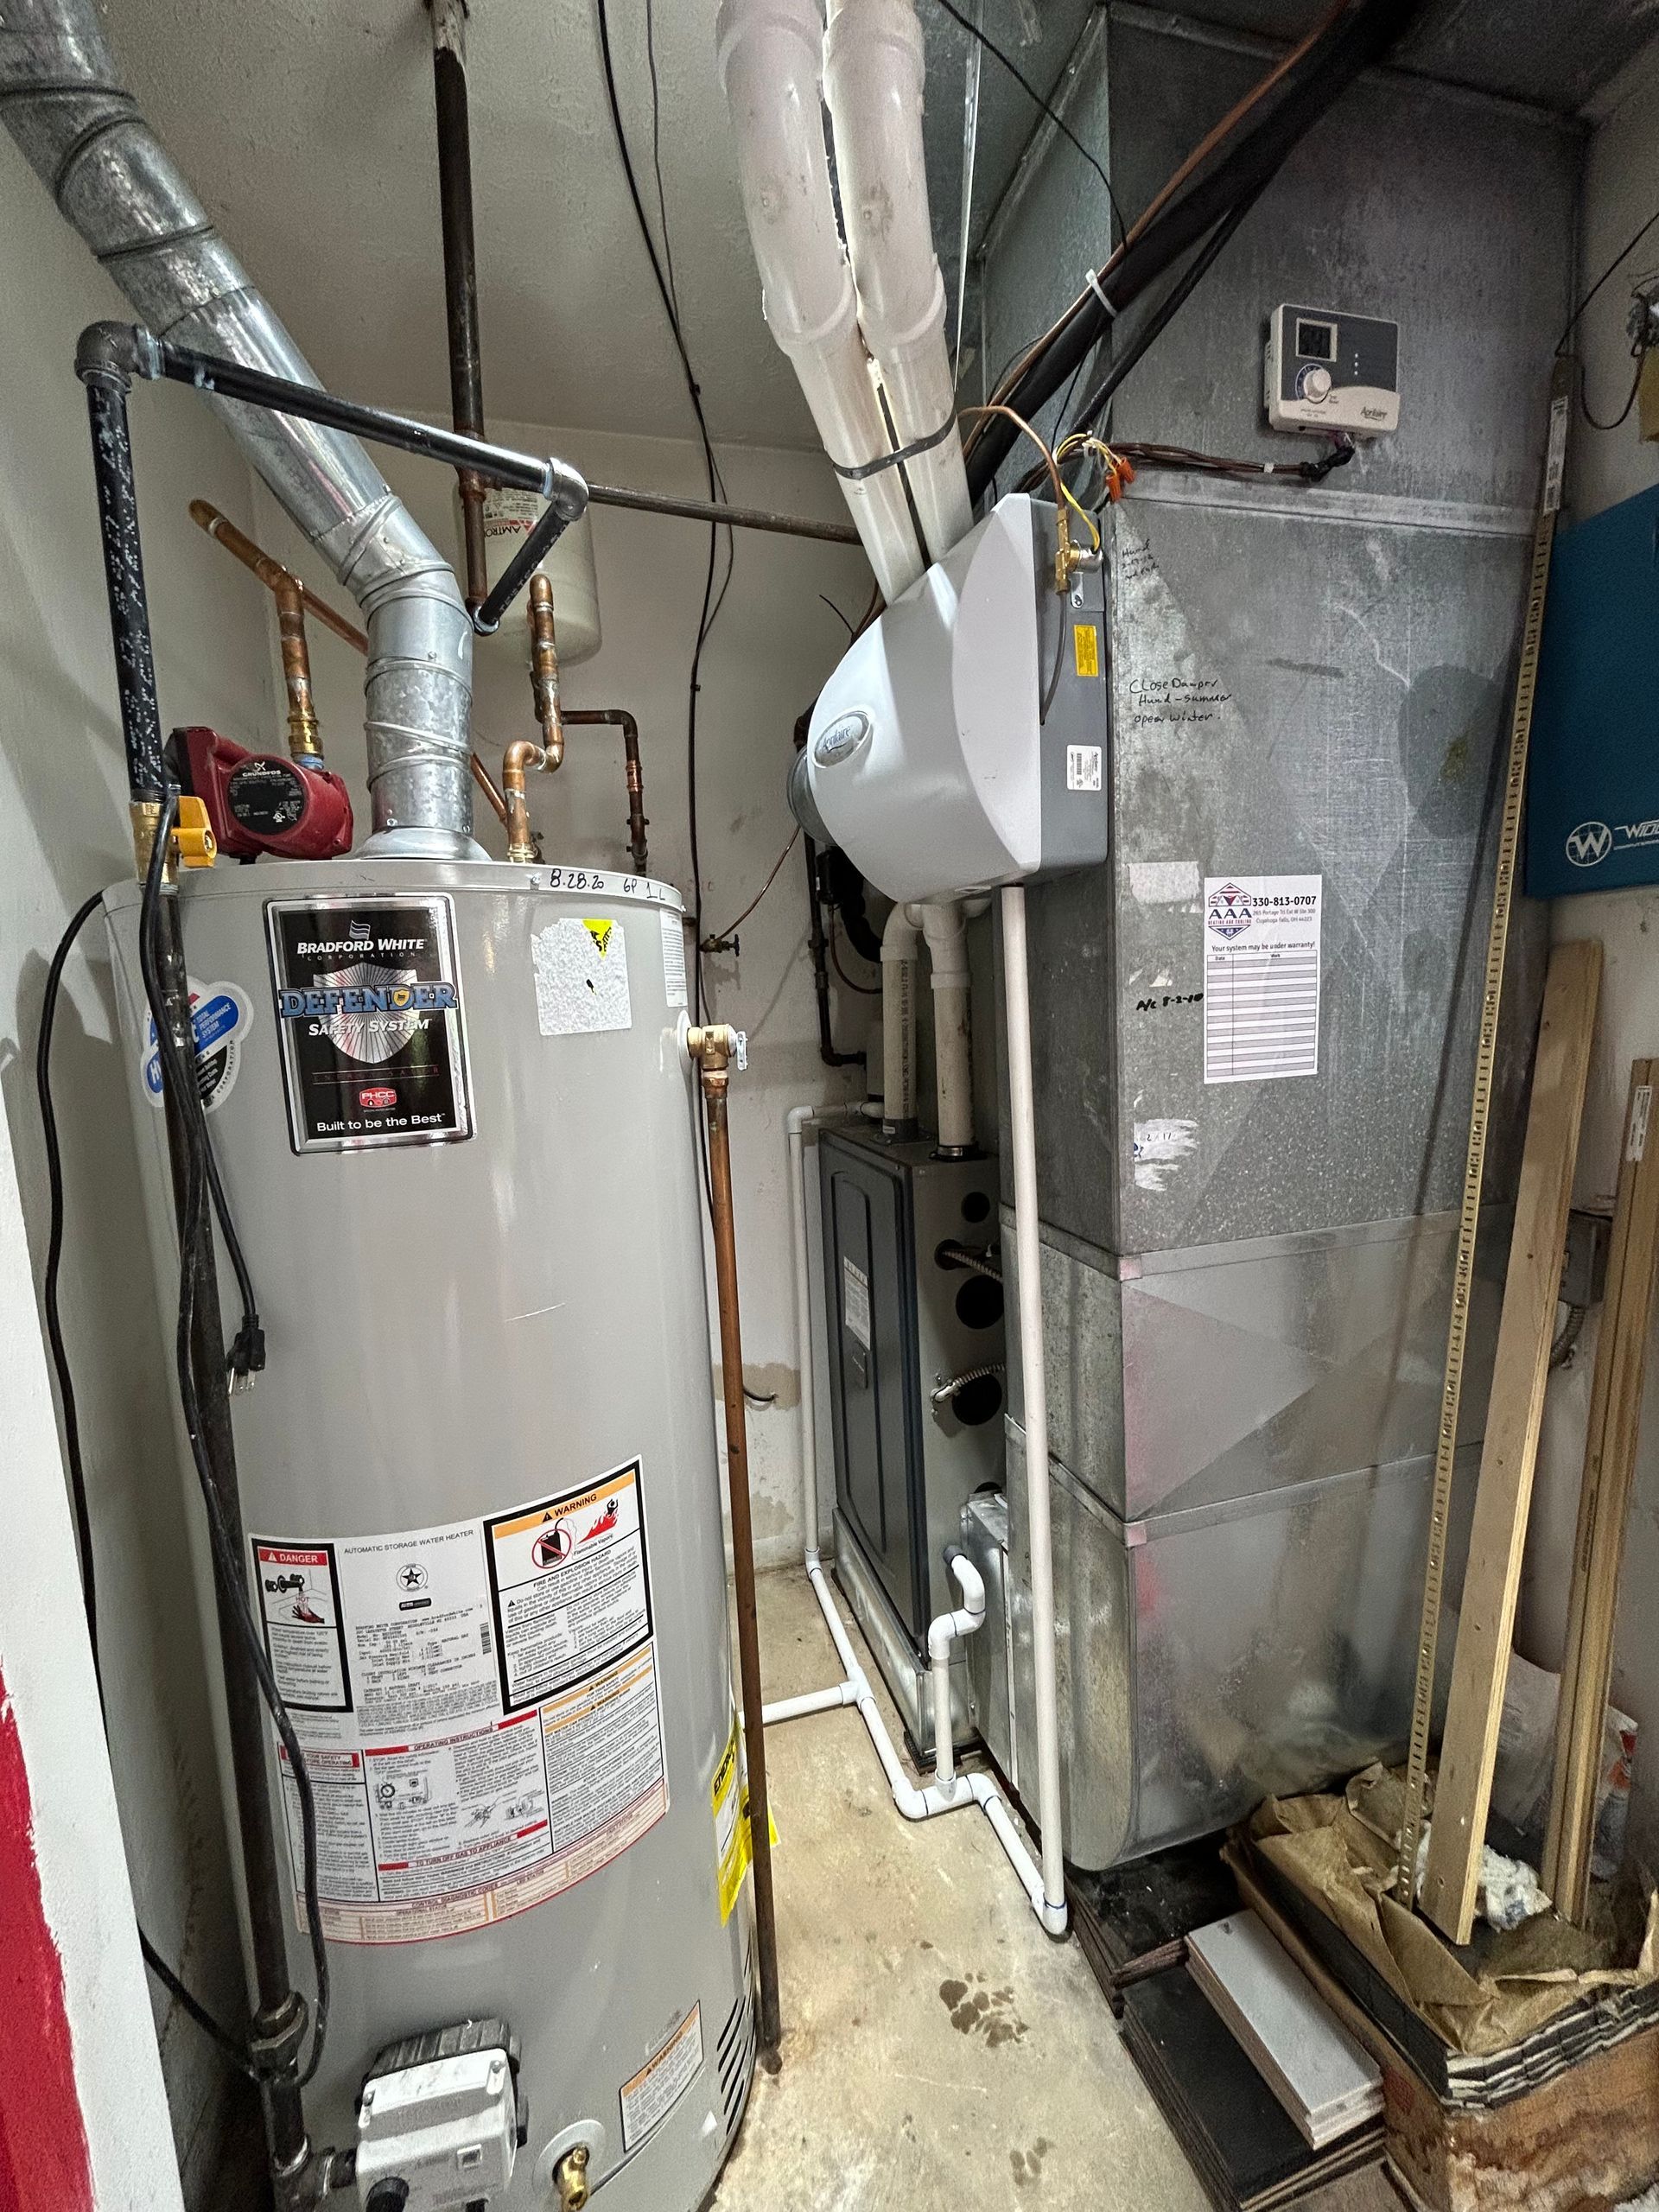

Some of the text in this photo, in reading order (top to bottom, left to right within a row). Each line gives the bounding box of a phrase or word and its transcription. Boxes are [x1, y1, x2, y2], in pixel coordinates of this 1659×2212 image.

[242, 769, 281, 778] GRUNDFOS
[1252, 896, 1317, 906] 330-813-0707
[1208, 908, 1252, 919] AAA
[296, 938, 425, 954] BRADFORD WHITE
[1226, 944, 1248, 953] system
[1287, 941, 1315, 950] warranty!
[307, 951, 416, 963] CORPORATION
[279, 982, 458, 1018] DEFENDER
[200, 1002, 232, 1030] PERFORMANCE
[201, 1021, 219, 1039] SYSTEM
[308, 1018, 430, 1036] SAFETY SYSTEM
[361, 1090, 395, 1100] PHCC
[317, 1121, 345, 1132] Built
[348, 1119, 361, 1129] to
[365, 1118, 382, 1128] be
[385, 1116, 408, 1127] the
[554, 1493, 597, 1516] WARNING
[344, 1529, 474, 1554] AUTOMATIC STORAGE WATER HEATER
[574, 1534, 613, 1556] Flammable Vapors
[279, 1553, 318, 1564] DANGER
[533, 1549, 612, 1588] FIRE AND EXPLOSION HAZARD
[547, 1579, 560, 1588] result
[595, 1670, 619, 1687] WARNING
[597, 1689, 620, 1707] WARNING
[414, 1728, 493, 1751] OPERATING INSTRUCTIONS
[652, 2031, 683, 2068] WARNING
